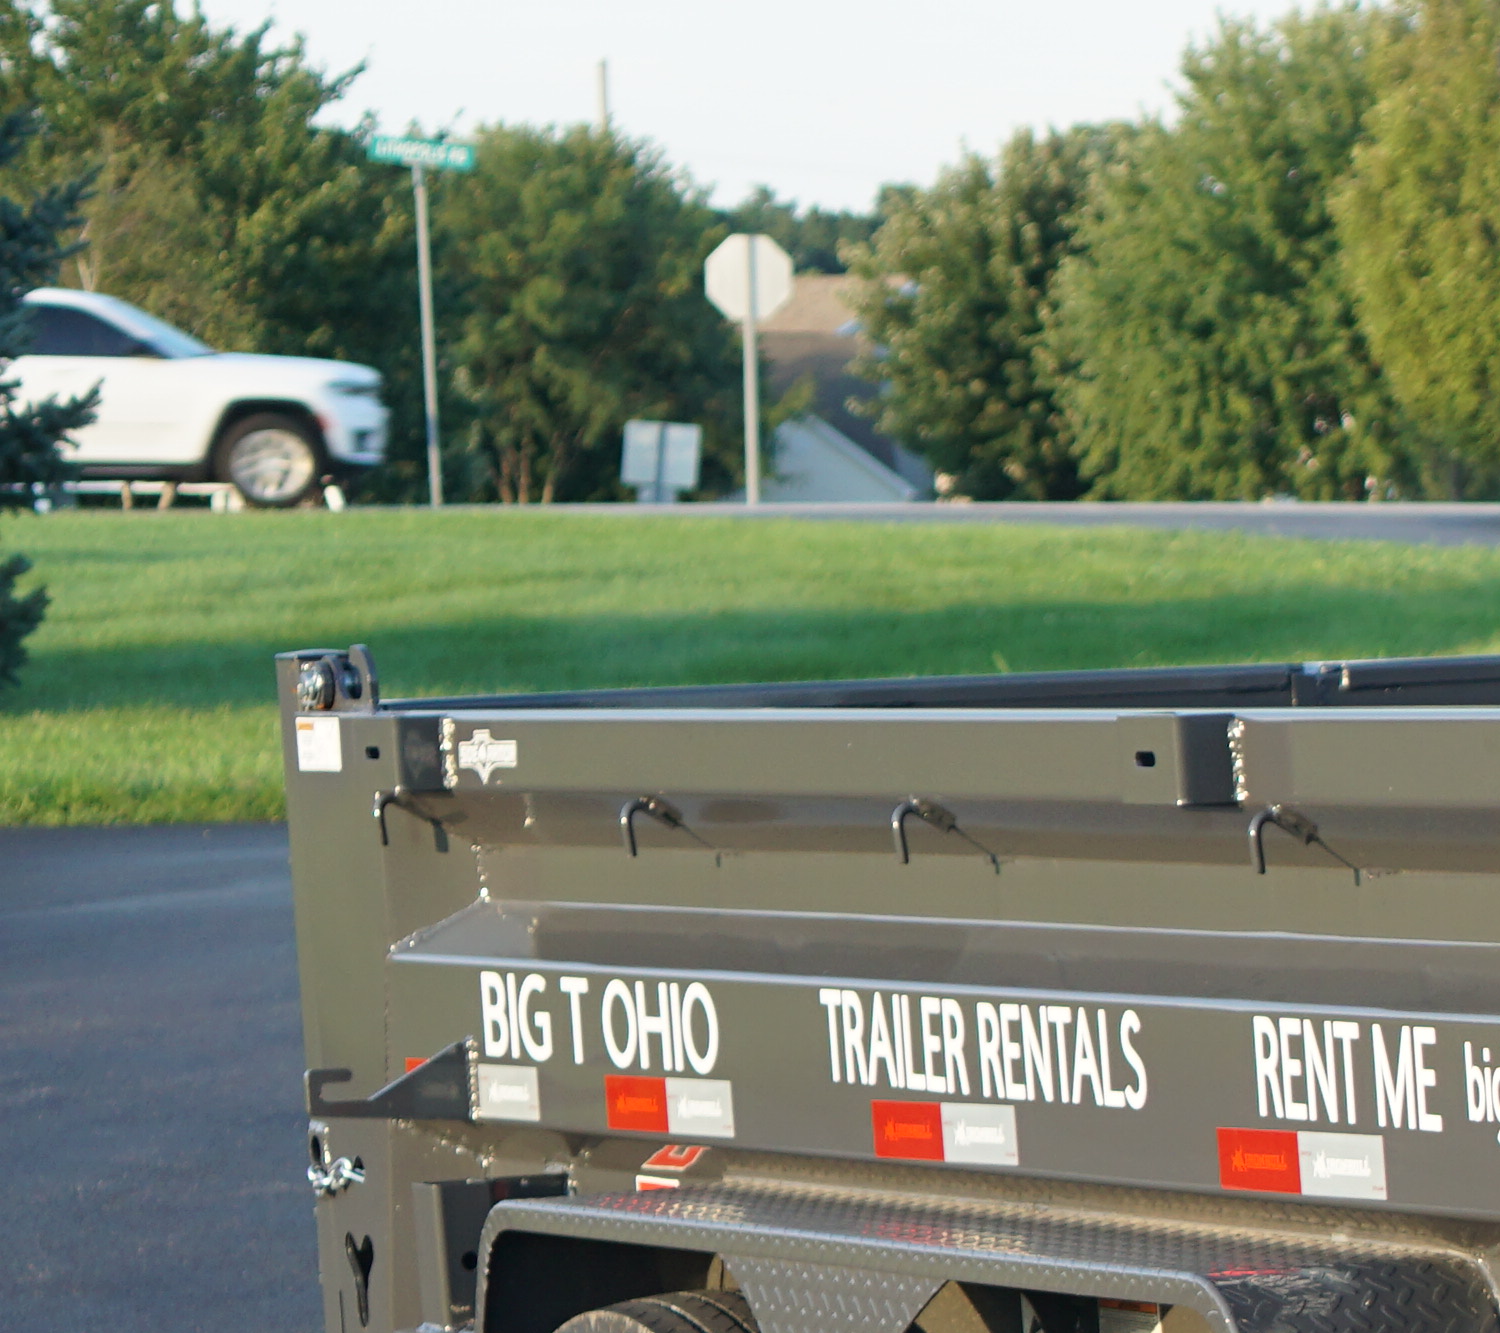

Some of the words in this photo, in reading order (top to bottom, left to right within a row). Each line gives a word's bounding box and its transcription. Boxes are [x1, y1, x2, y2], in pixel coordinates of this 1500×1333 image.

[480, 970, 553, 1063] BIG
[559, 976, 589, 1065] T
[602, 977, 719, 1075] OHIO
[819, 987, 971, 1096] TRAILER
[976, 1001, 1148, 1111] RENTALS
[1252, 1014, 1360, 1125] RENT
[1371, 1022, 1444, 1133] ME
